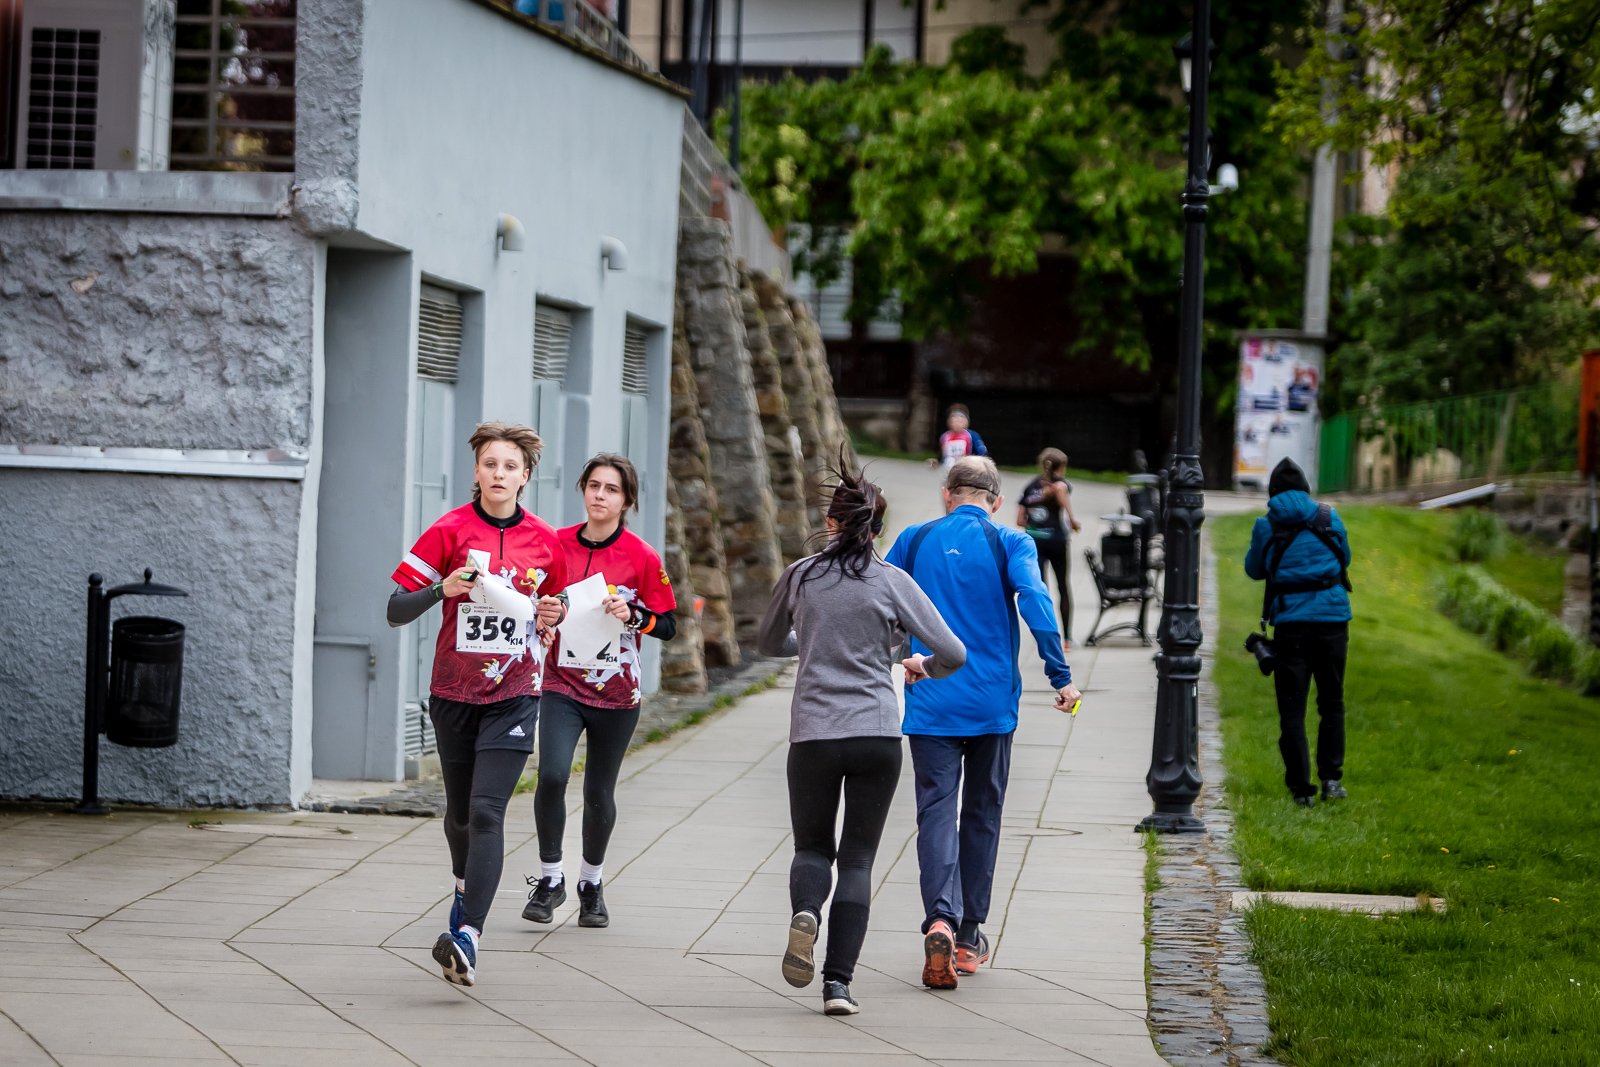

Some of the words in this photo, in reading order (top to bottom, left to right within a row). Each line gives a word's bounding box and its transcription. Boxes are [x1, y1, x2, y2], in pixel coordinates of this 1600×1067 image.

[466, 615, 516, 642] 359
[510, 638, 523, 646] K14
[605, 655, 618, 663] K14
